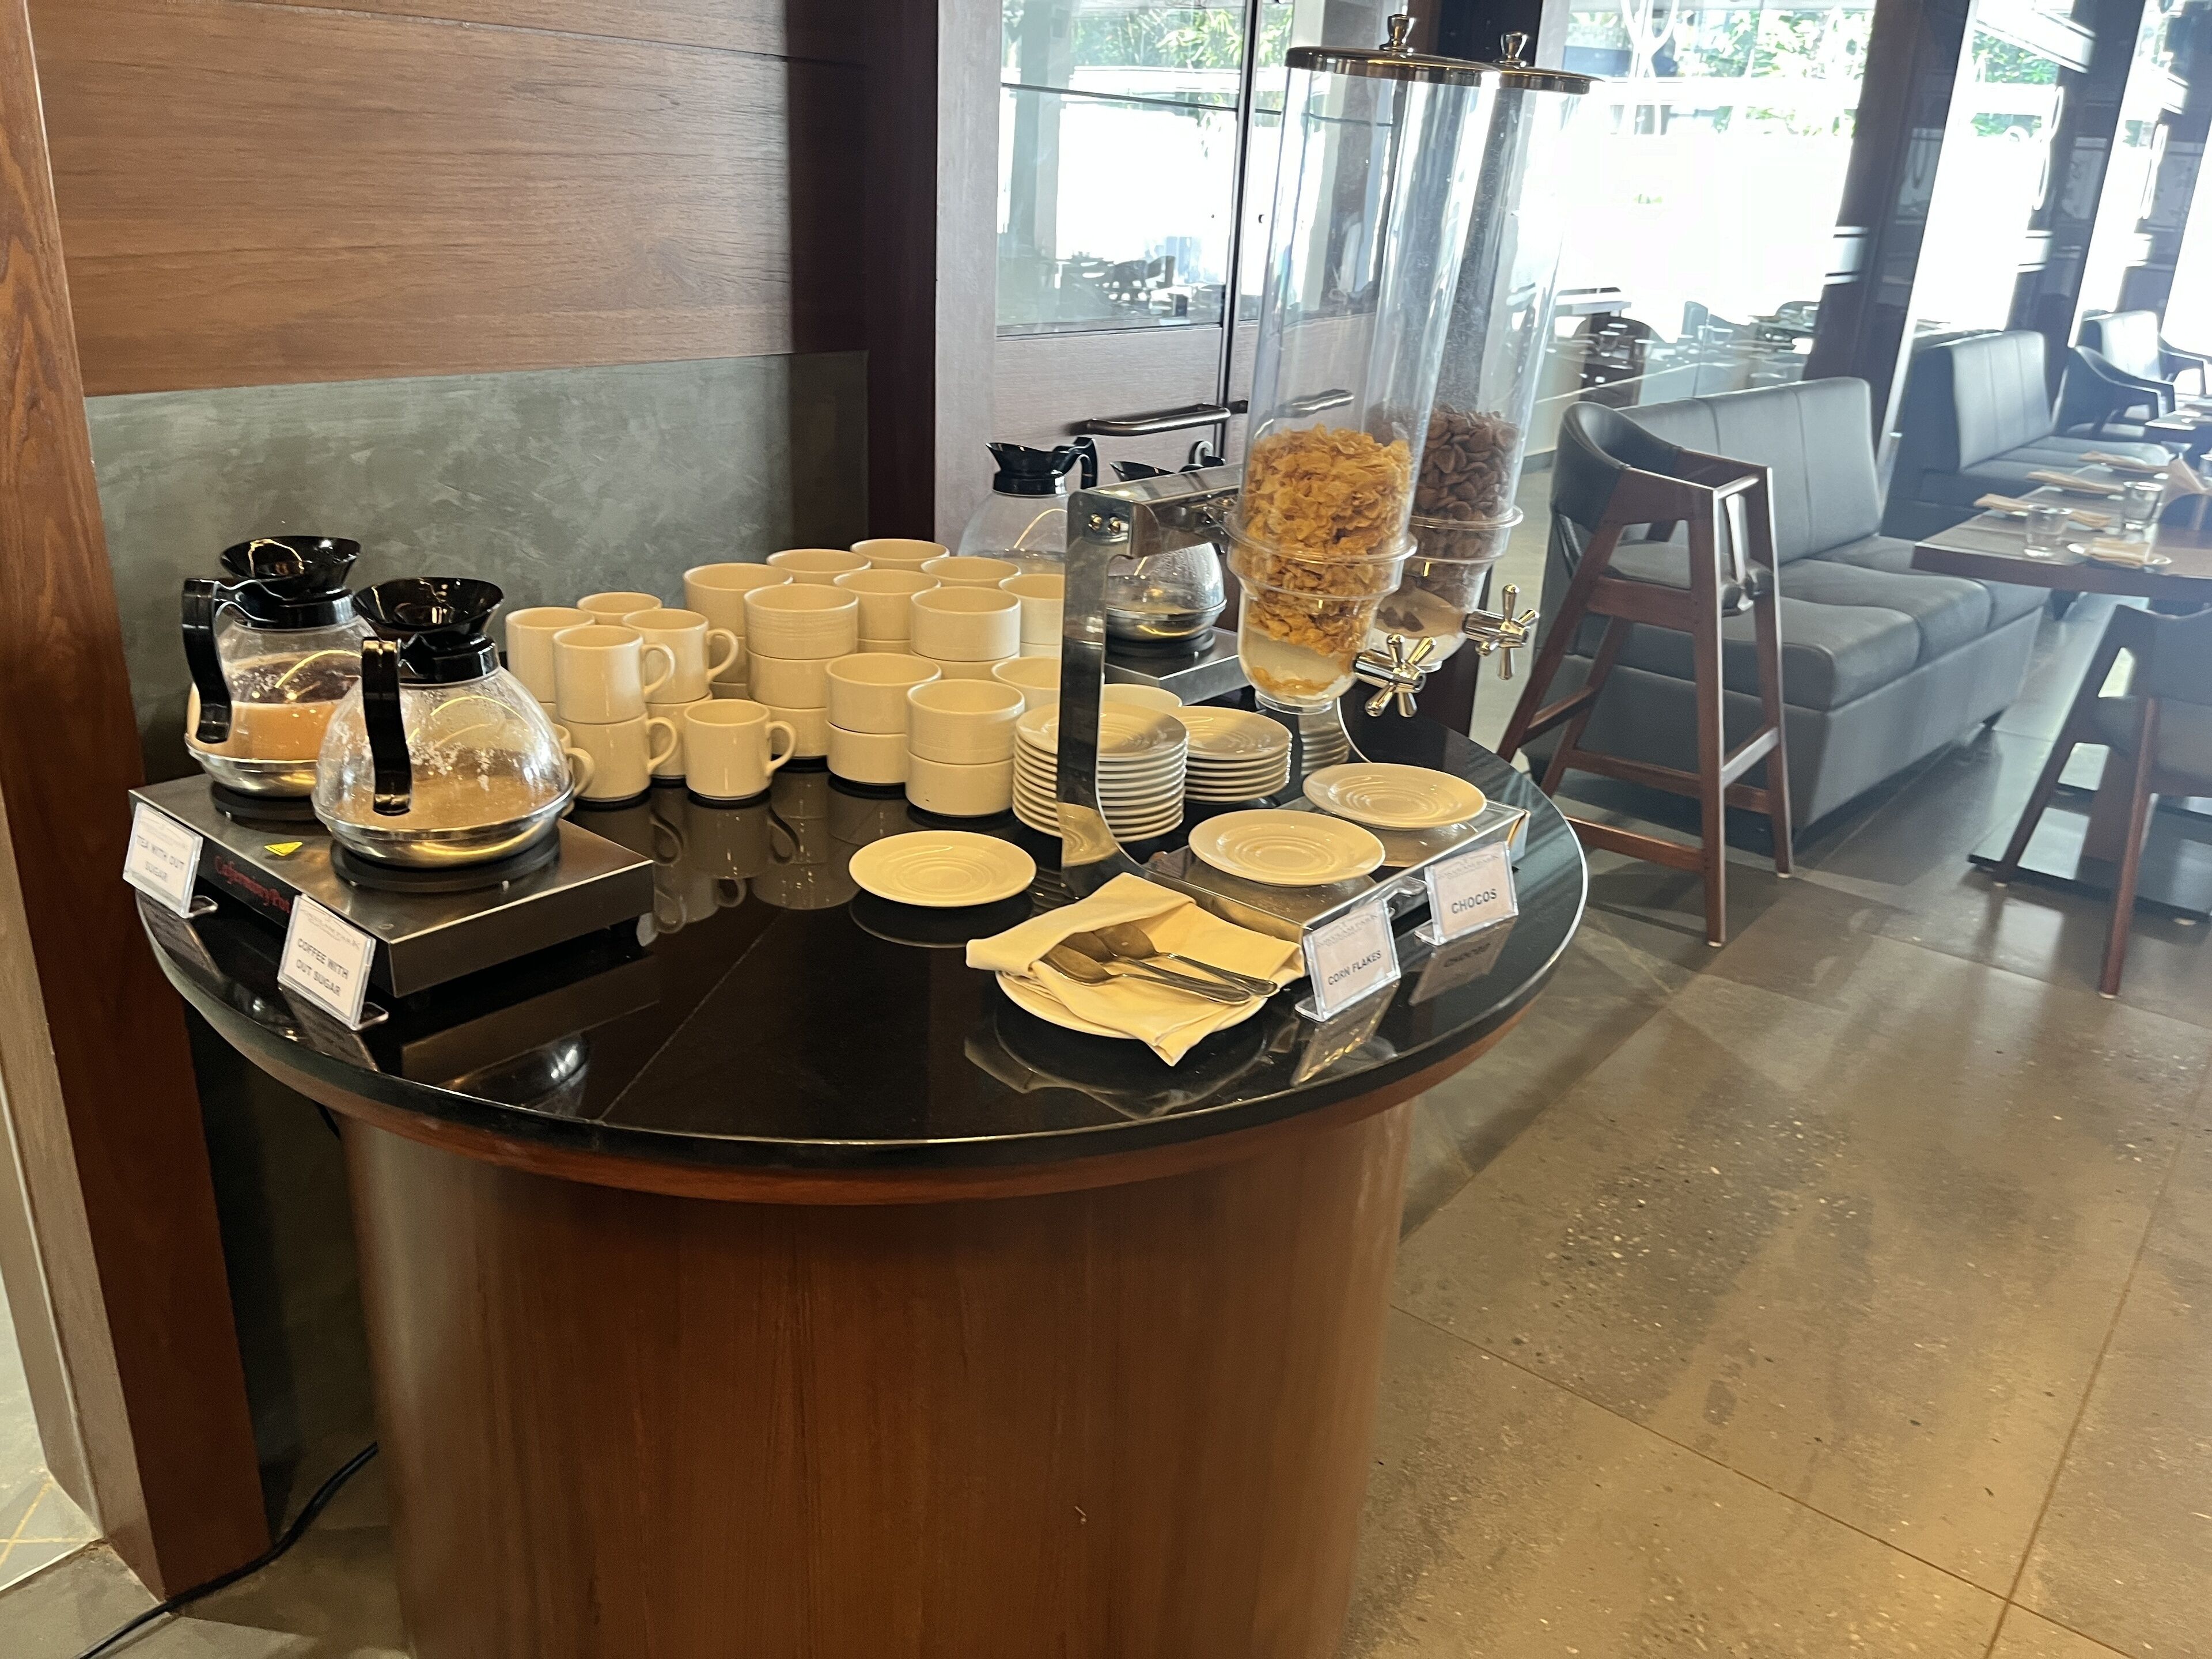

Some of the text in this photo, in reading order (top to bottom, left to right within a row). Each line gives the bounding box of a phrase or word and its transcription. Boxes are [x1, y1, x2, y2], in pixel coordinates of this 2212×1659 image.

[137, 834, 149, 849] TEA
[150, 843, 169, 862] WITH
[169, 855, 185, 870] OUT
[145, 861, 168, 882] SUGAR
[1451, 888, 1497, 914] CHOCOS
[297, 938, 349, 979] COFFEE WITH
[1328, 950, 1382, 985] CORN FLAKES
[296, 959, 341, 997] OUT SUGAR
